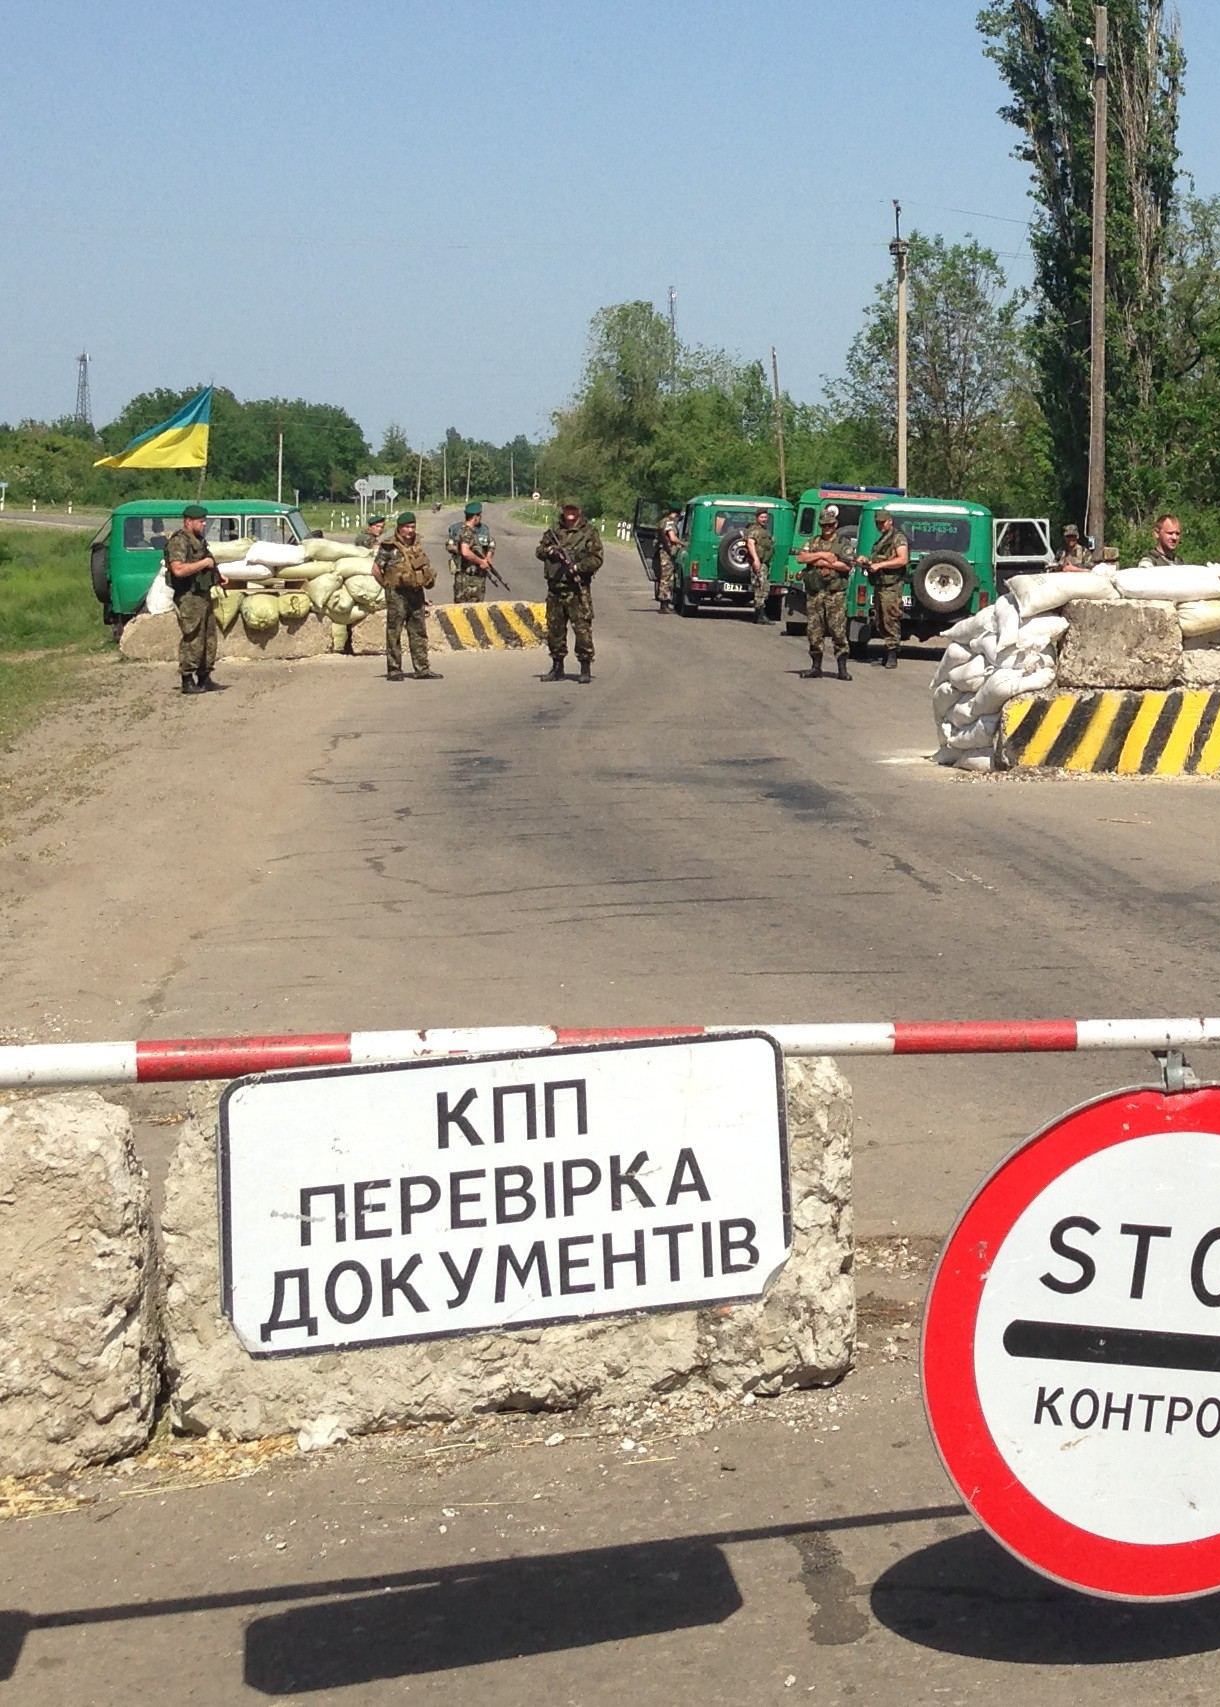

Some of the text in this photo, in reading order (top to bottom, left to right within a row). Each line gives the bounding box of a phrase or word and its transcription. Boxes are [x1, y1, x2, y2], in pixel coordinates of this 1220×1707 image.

[436, 1078, 588, 1149] КПП
[300, 1147, 712, 1247] ПЕРЕВІРКА
[260, 1217, 760, 1343] ДОКУМЕНТІВ
